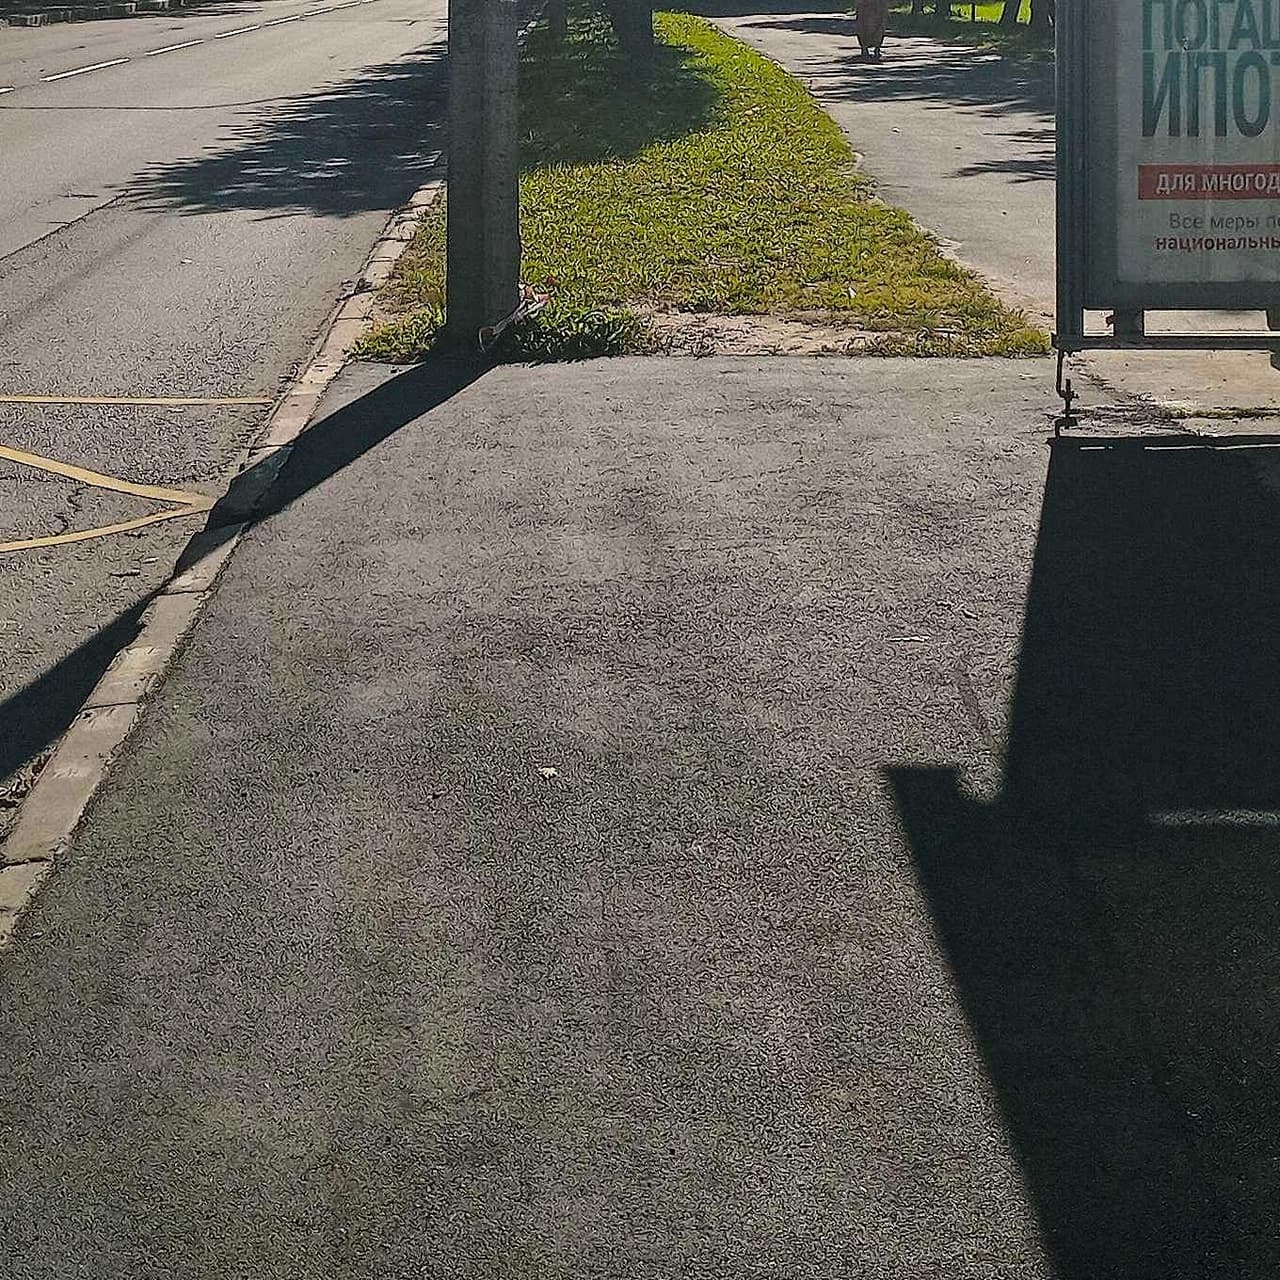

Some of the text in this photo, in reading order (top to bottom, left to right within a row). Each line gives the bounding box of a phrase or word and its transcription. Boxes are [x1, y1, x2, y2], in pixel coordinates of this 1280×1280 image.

[1156, 173, 1195, 194] ДЛЯ
[1170, 213, 1203, 229] Все
[1210, 216, 1259, 233] меры
